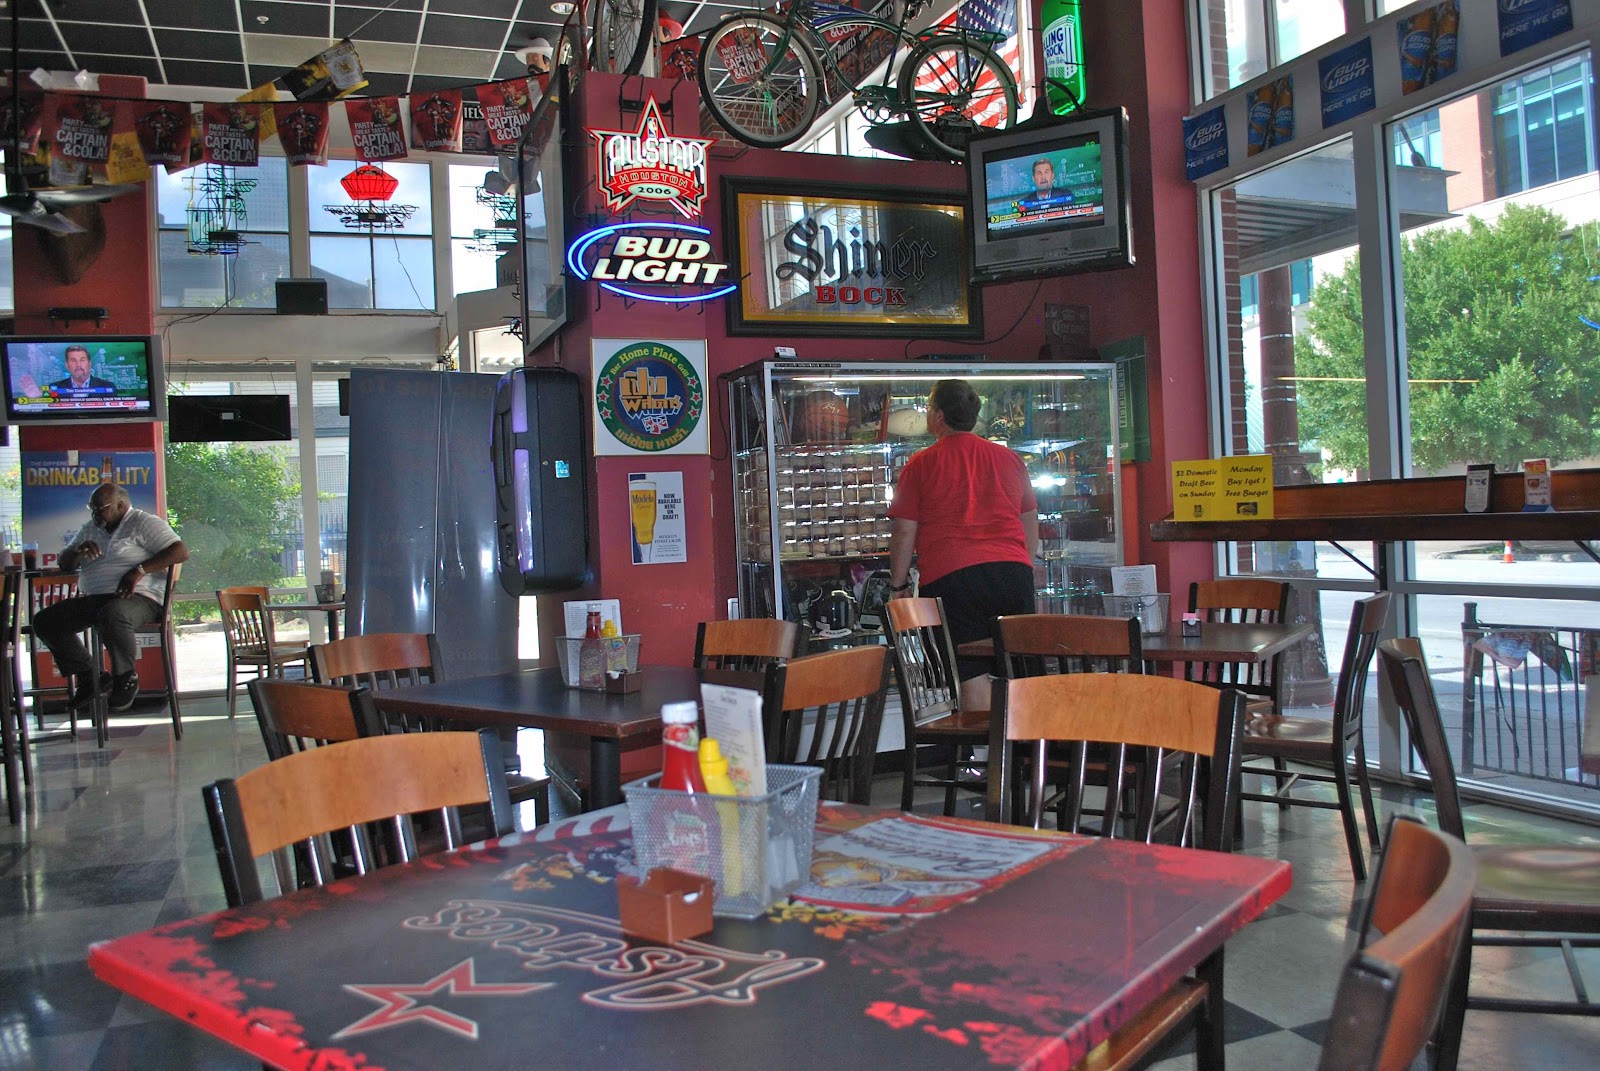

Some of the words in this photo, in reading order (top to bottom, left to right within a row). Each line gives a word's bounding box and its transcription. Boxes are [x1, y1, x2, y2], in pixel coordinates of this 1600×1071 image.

[1502, 22, 1530, 39] HERE
[1532, 14, 1550, 26] WE
[1552, 6, 1568, 18] GO
[1046, 42, 1064, 58] ROCK
[1327, 64, 1370, 89] LIGHT
[1333, 58, 1366, 79] BUD
[486, 104, 506, 113] PARTY
[1322, 100, 1344, 113] HERE
[1345, 94, 1359, 106] WE
[1360, 88, 1372, 98] GO
[62, 118, 84, 127] PARTY
[208, 124, 230, 132] PARTY
[354, 122, 374, 130] PARTY
[487, 112, 531, 130] CAPTAIN
[56, 129, 108, 147] CAPTAIN
[354, 130, 400, 147] CAPTAIN
[1192, 129, 1224, 148] LIGHT
[1197, 123, 1222, 138] BUD
[205, 136, 254, 150] CAPTAIN
[364, 142, 404, 158] &COLA!
[62, 144, 108, 160] &COLA!
[212, 148, 256, 162] &COLA!
[1186, 158, 1205, 168] HERE
[1206, 153, 1216, 162] WE
[1216, 149, 1226, 157] GO
[619, 171, 688, 187] HOUSTON
[638, 186, 672, 195] 2006
[613, 236, 710, 260] BUD
[776, 217, 937, 284] Shiner
[592, 258, 728, 284] LIGHT
[814, 286, 906, 306] BOCK
[610, 363, 621, 376] Bar
[618, 348, 649, 364] Home
[652, 346, 678, 364] Plate
[1230, 465, 1264, 473] Monday
[632, 494, 654, 504] Modelo
[402, 900, 825, 1010] Astros
